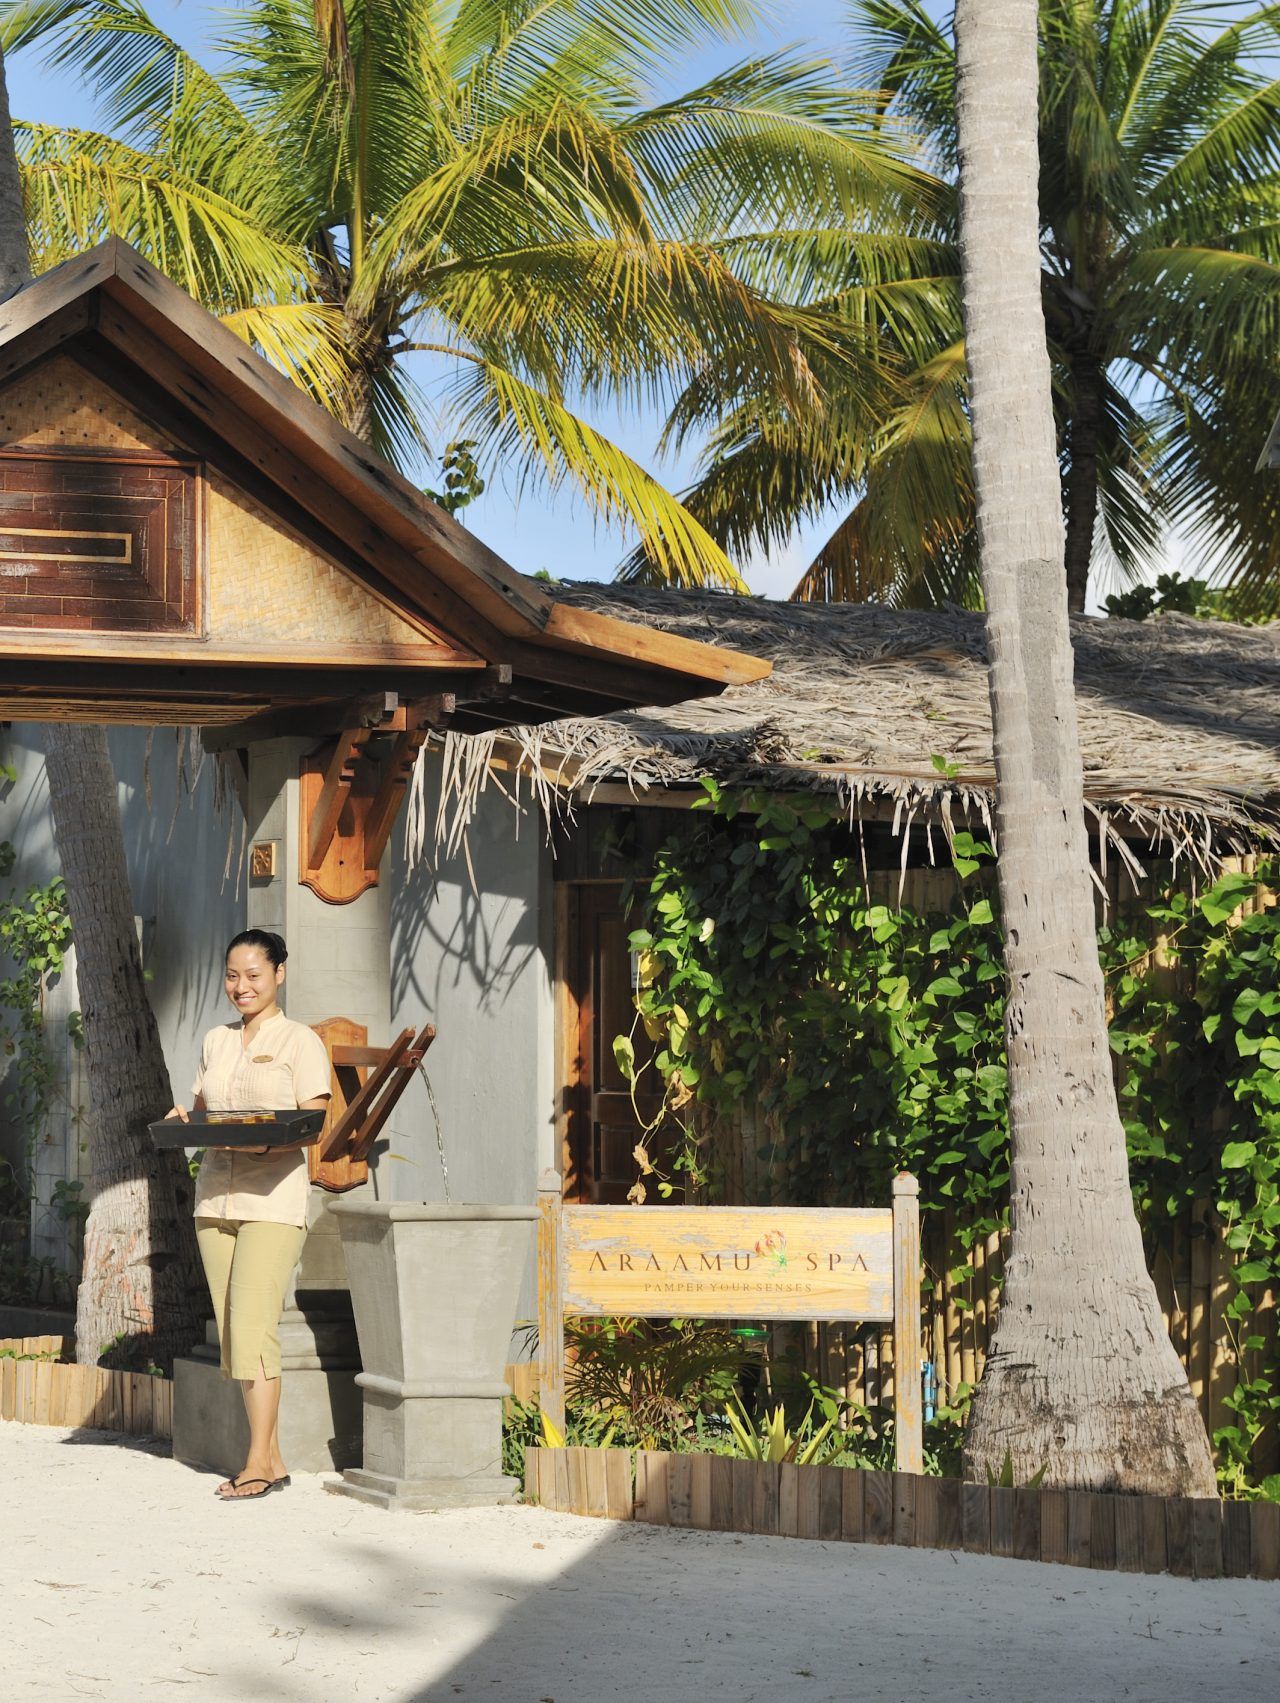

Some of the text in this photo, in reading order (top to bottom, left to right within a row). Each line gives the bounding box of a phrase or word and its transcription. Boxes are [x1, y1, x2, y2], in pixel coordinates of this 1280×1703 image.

[589, 1251, 870, 1271] ARAAMU SPA
[644, 1283, 812, 1292] PAMPER YOUR SENSES
